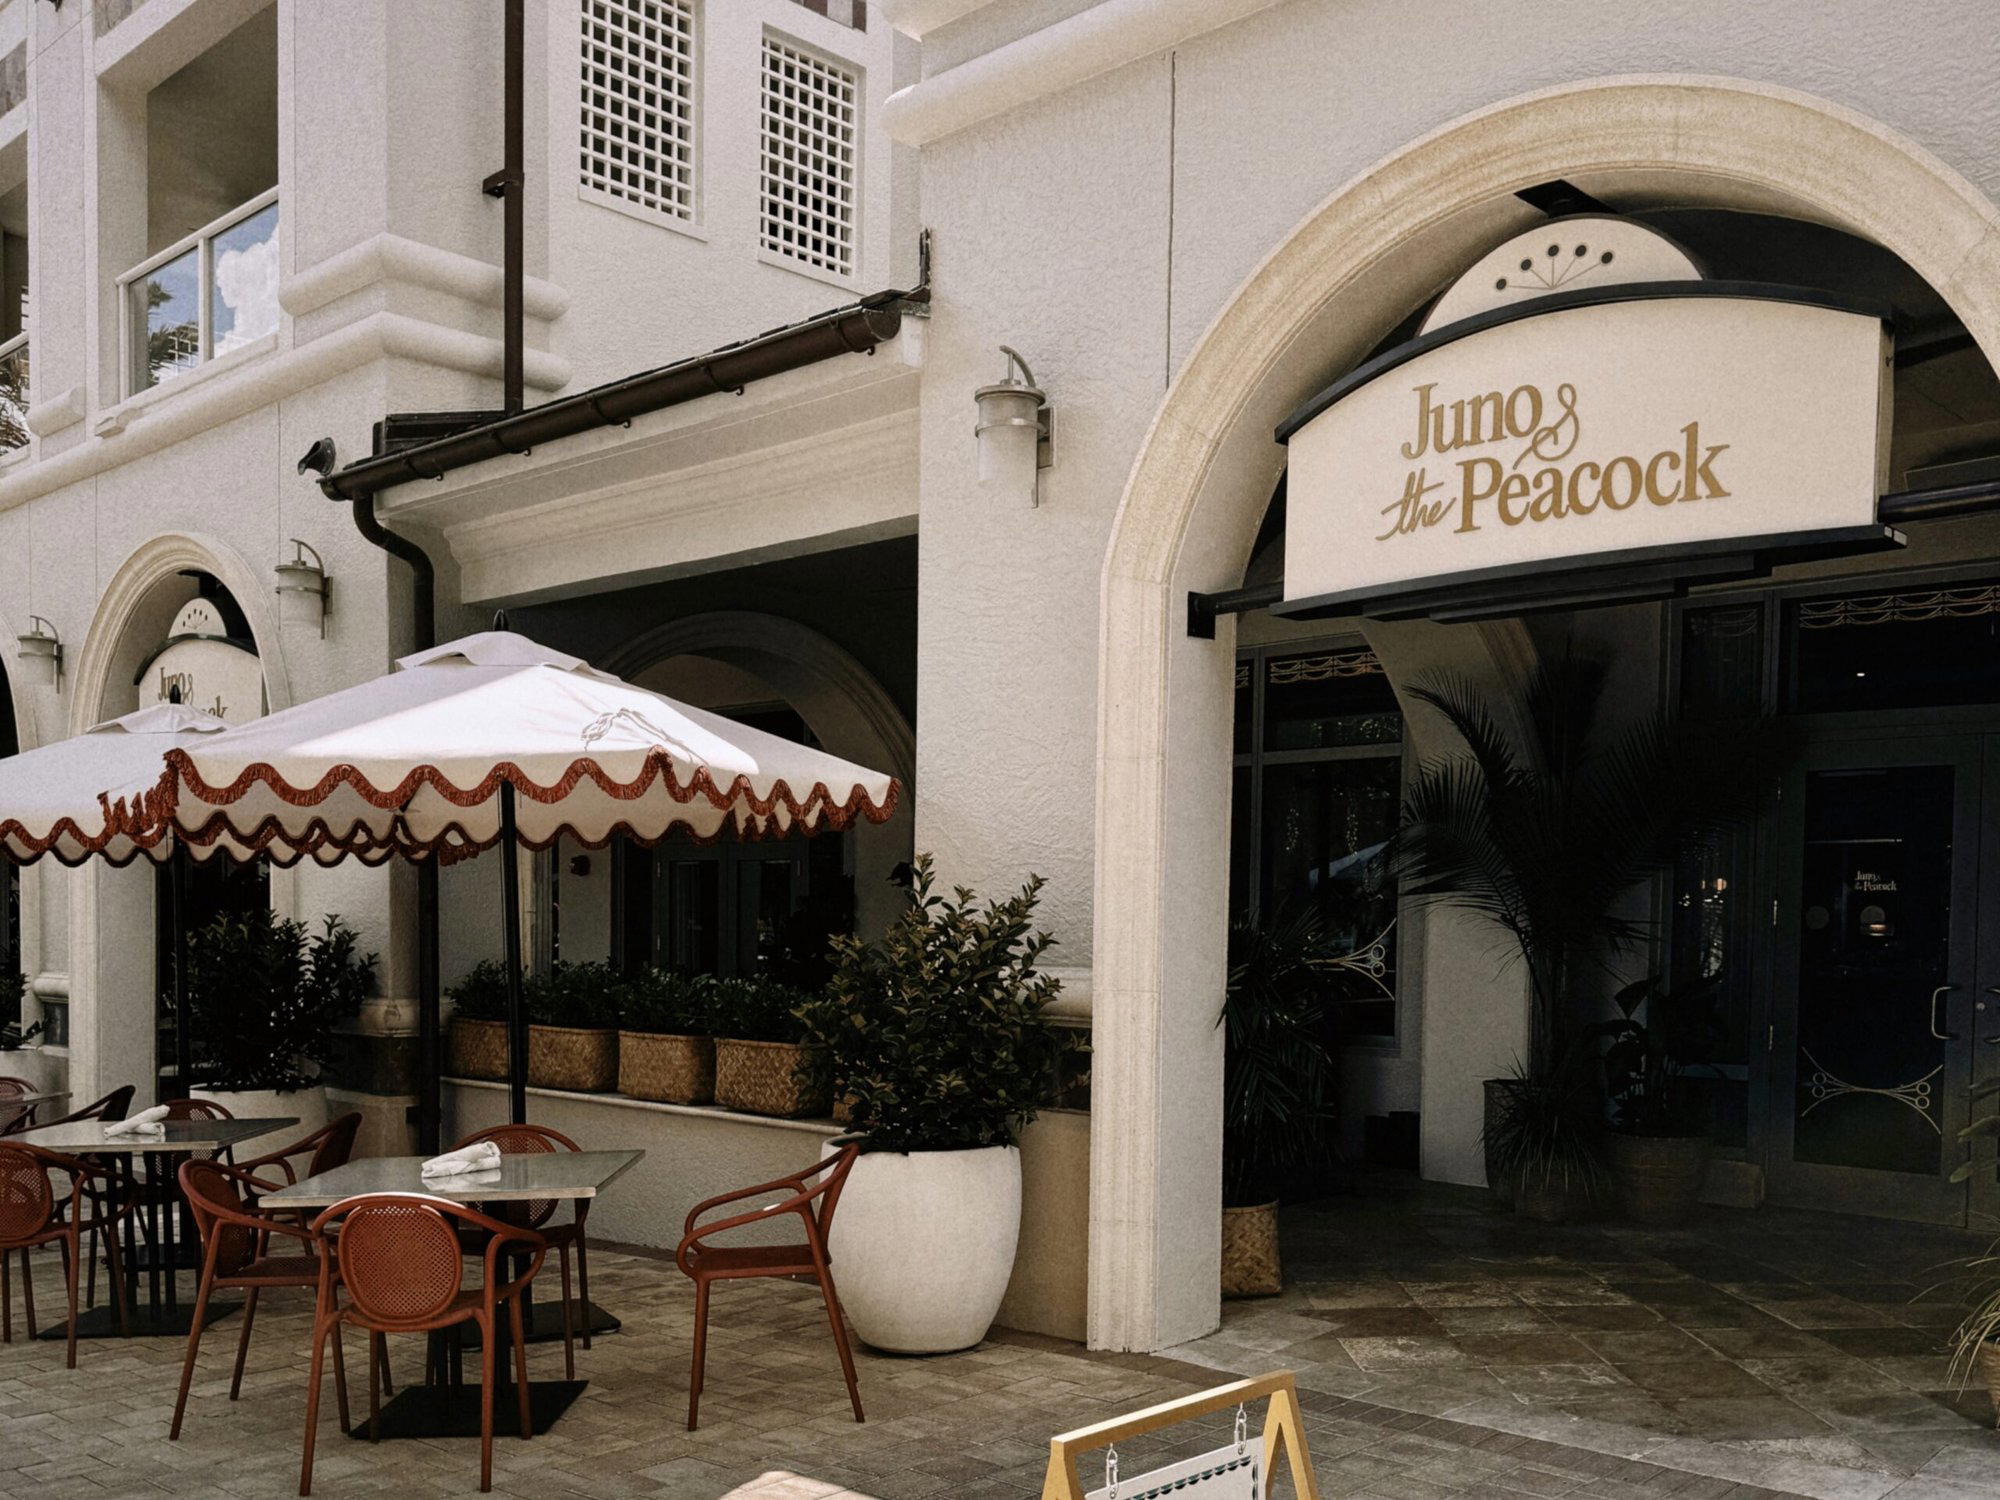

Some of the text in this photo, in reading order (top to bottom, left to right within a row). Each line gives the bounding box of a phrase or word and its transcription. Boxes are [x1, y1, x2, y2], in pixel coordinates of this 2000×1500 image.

[1401, 383, 1580, 469] Juno &
[1375, 422, 1731, 541] the Peacock
